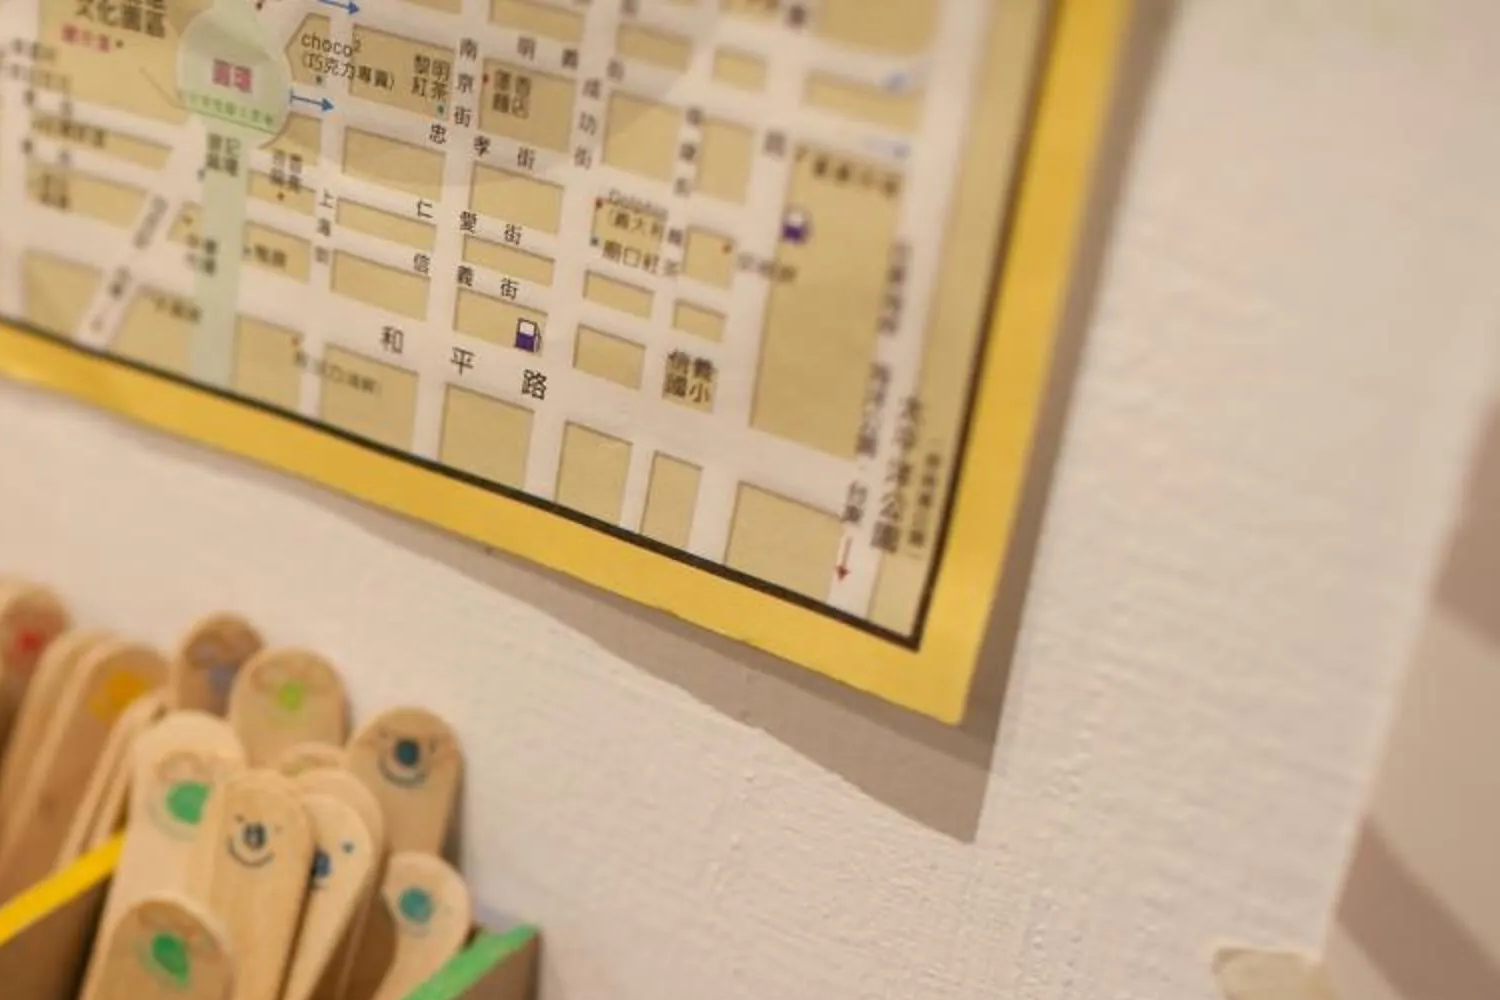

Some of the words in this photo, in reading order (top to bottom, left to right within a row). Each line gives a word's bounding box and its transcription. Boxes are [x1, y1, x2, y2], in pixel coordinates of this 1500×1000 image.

[416, 200, 523, 245] 仁愛街
[413, 252, 519, 300] 信義街
[380, 326, 548, 400] 和平路
